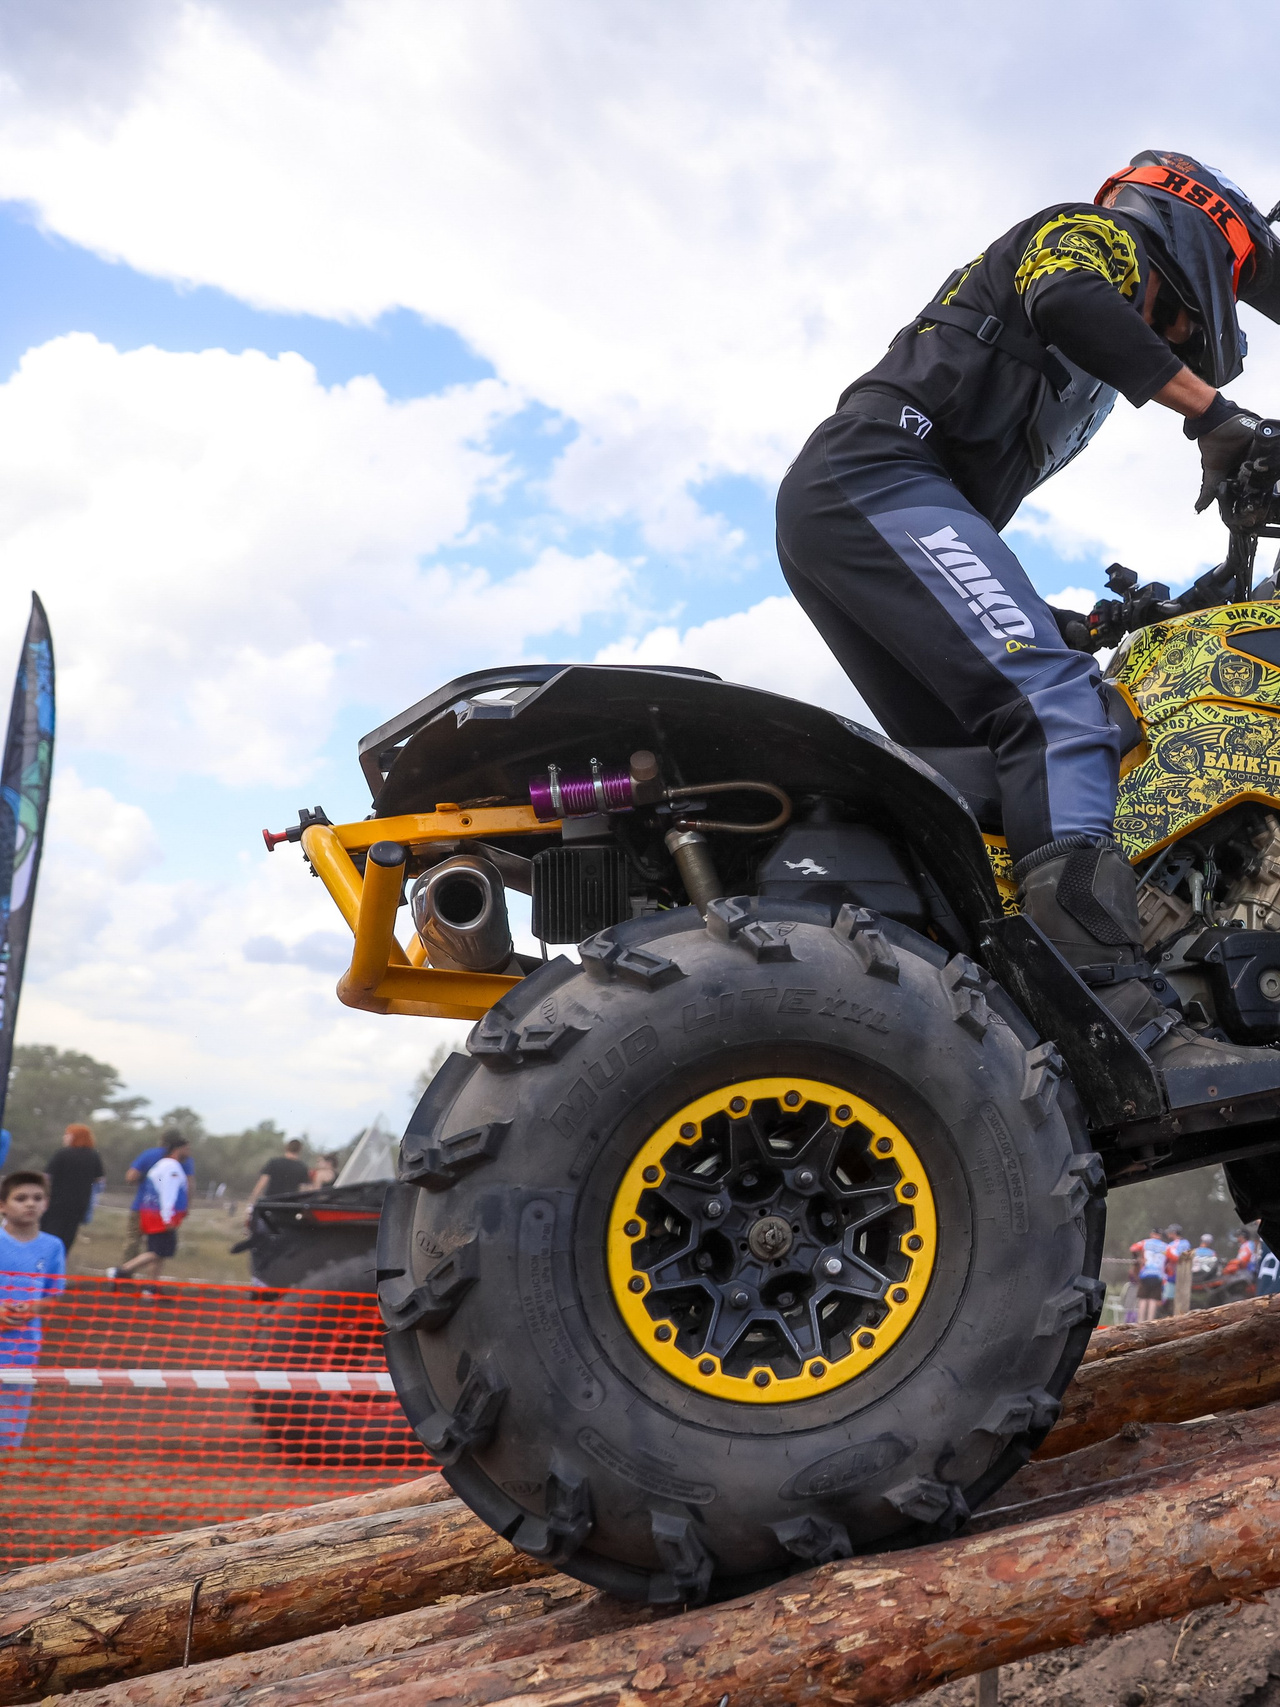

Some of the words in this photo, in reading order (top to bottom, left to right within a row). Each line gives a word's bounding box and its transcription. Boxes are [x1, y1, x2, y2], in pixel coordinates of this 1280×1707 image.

[914, 524, 1036, 639] YOKO
[1225, 607, 1280, 626] BIKEPO
[1155, 788, 1190, 800] FOX
[1135, 803, 1167, 816] NGK
[1114, 818, 1144, 830] ITP
[549, 1024, 660, 1140] MUD
[682, 986, 818, 1034] LITE
